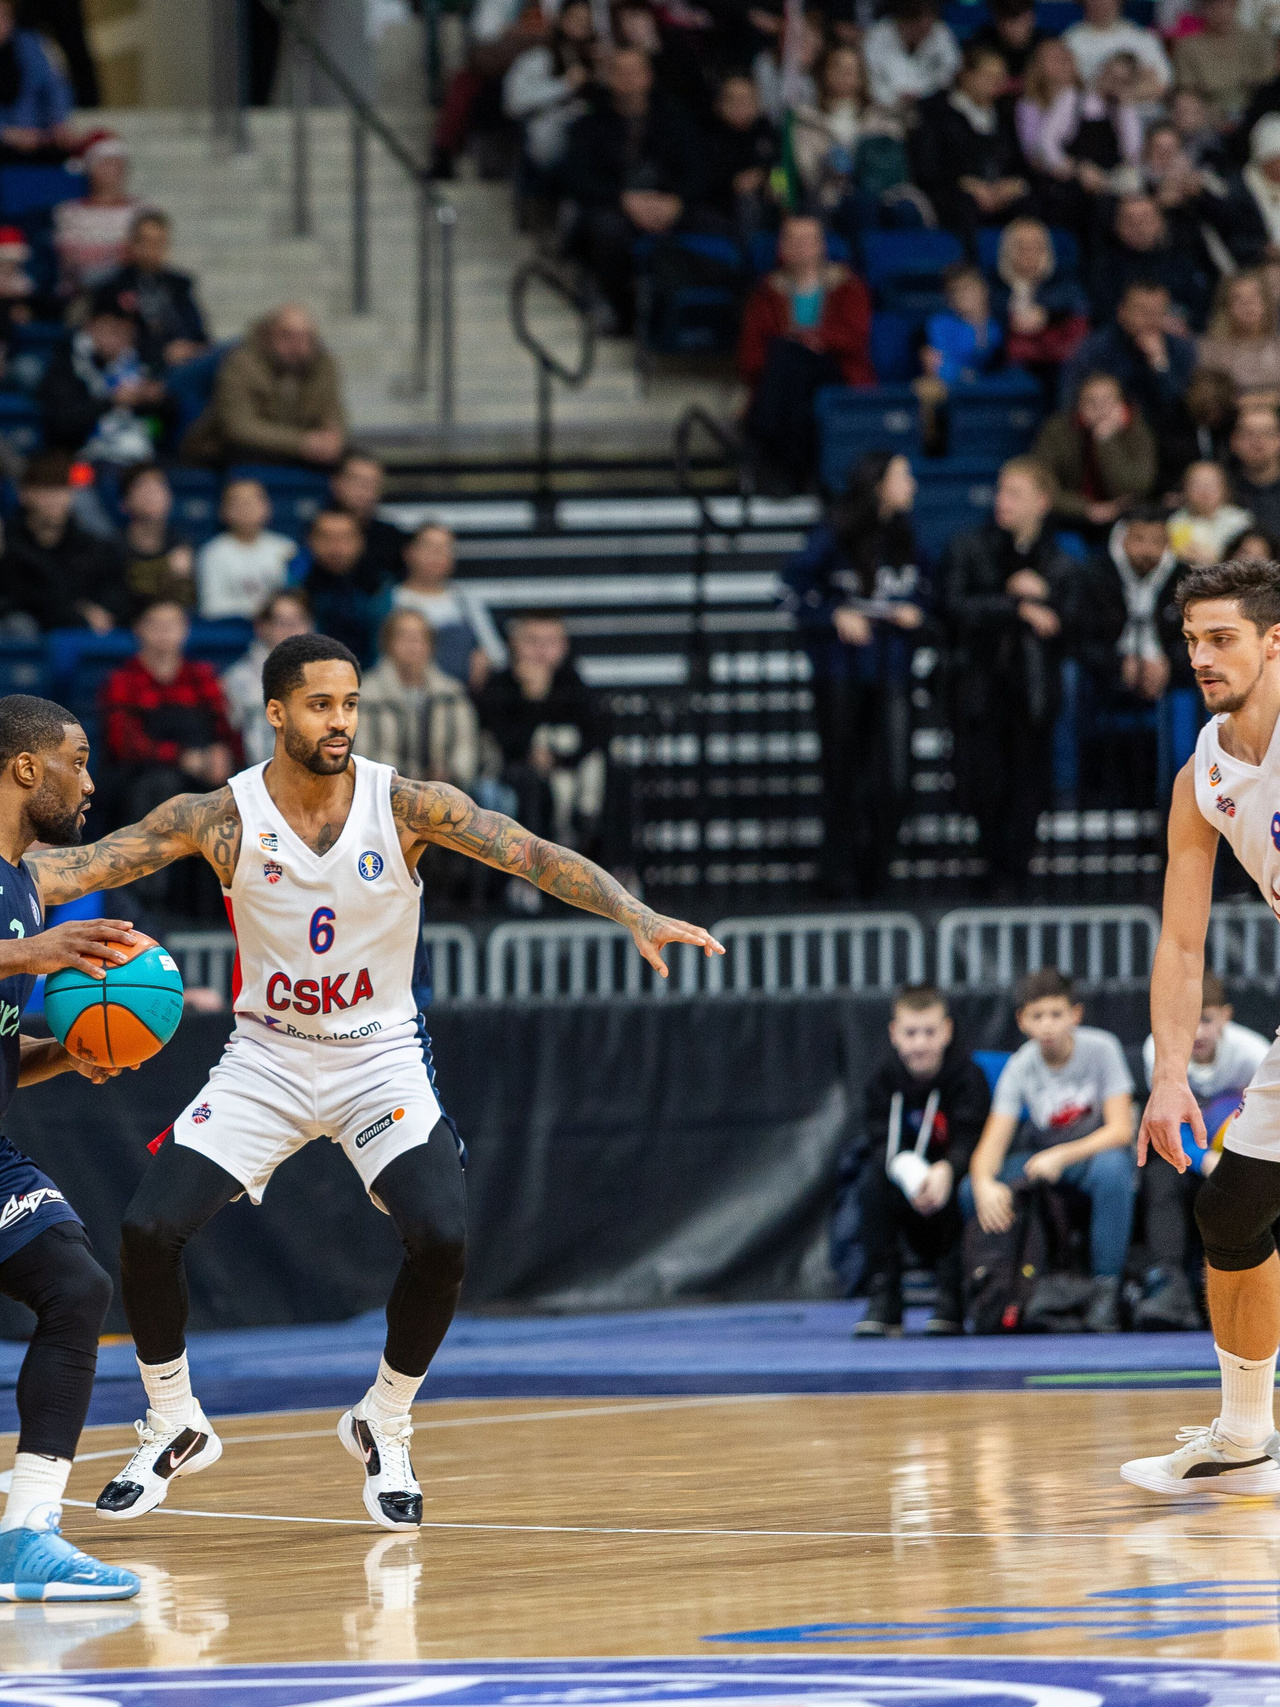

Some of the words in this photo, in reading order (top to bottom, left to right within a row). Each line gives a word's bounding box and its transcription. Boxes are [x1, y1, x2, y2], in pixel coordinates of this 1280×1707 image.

[309, 906, 336, 955] 6
[266, 967, 374, 1016] CSKA
[357, 1117, 391, 1146] Winline
